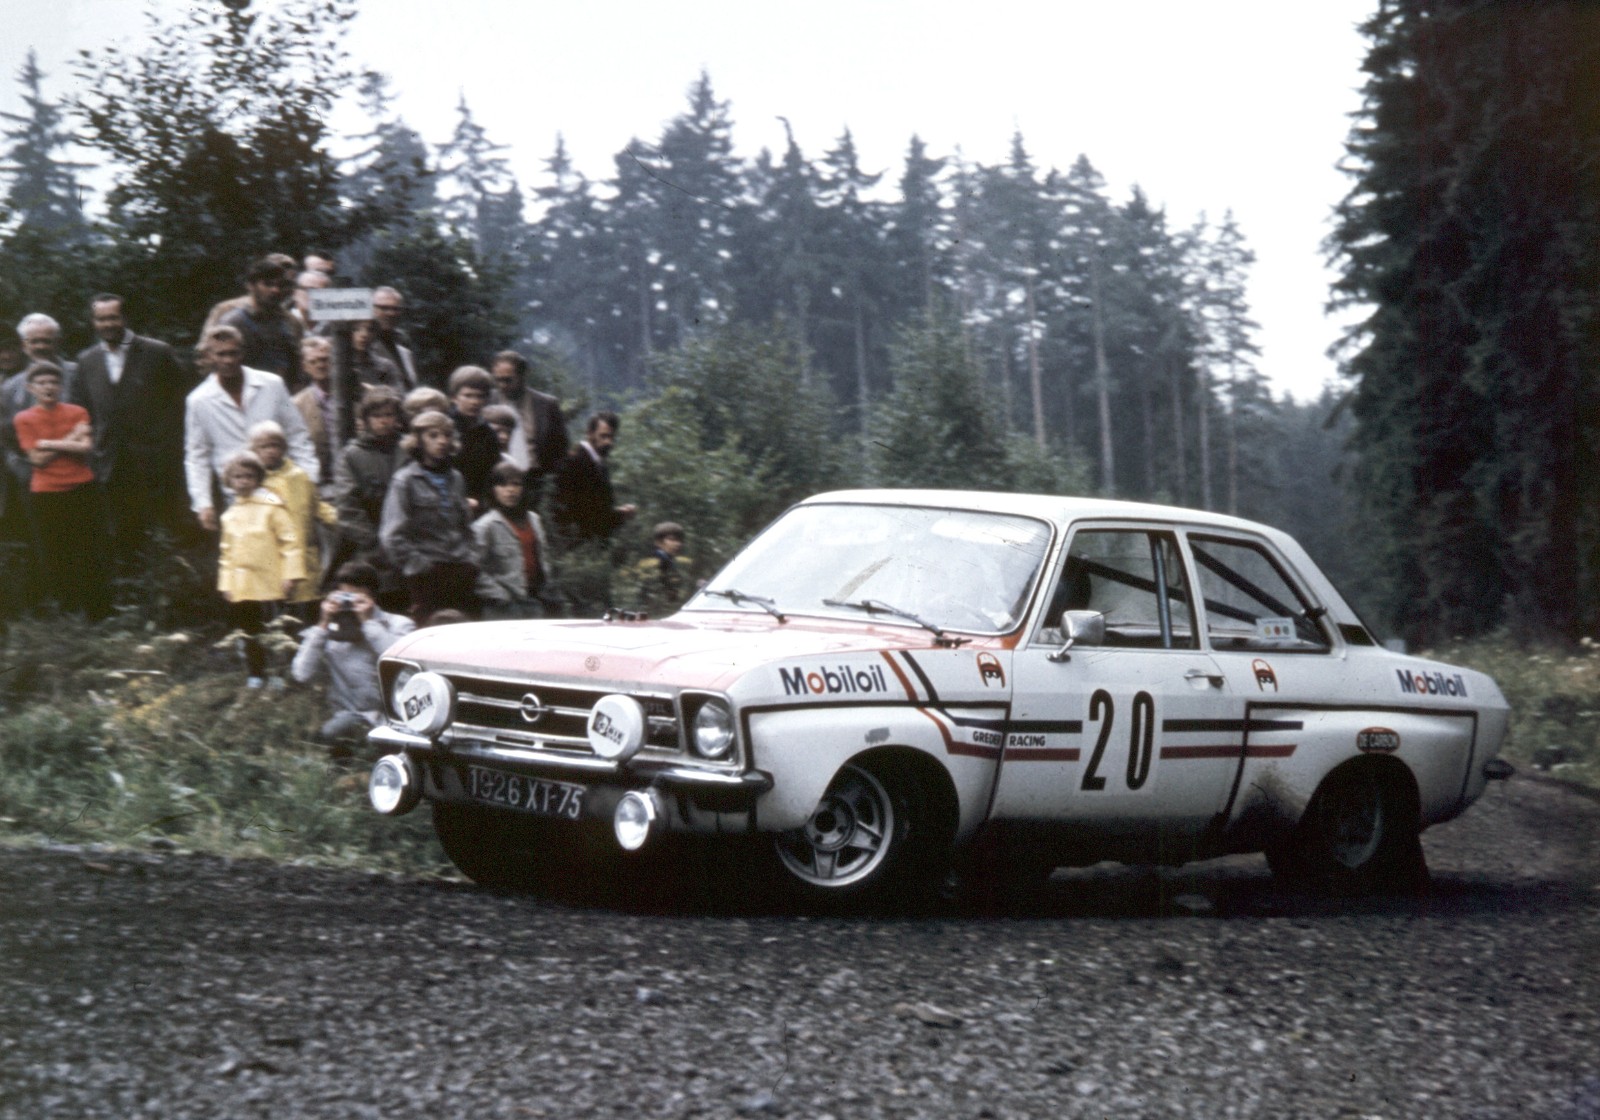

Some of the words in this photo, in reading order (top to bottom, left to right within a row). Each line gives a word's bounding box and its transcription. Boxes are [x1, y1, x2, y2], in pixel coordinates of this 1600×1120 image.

[778, 664, 888, 696] Mobiloil
[1395, 668, 1468, 697] Mobiloil
[1009, 735, 1046, 747] RACING
[1080, 688, 1155, 792] 20
[470, 767, 520, 805] 1926
[526, 777, 583, 819] XT-75
